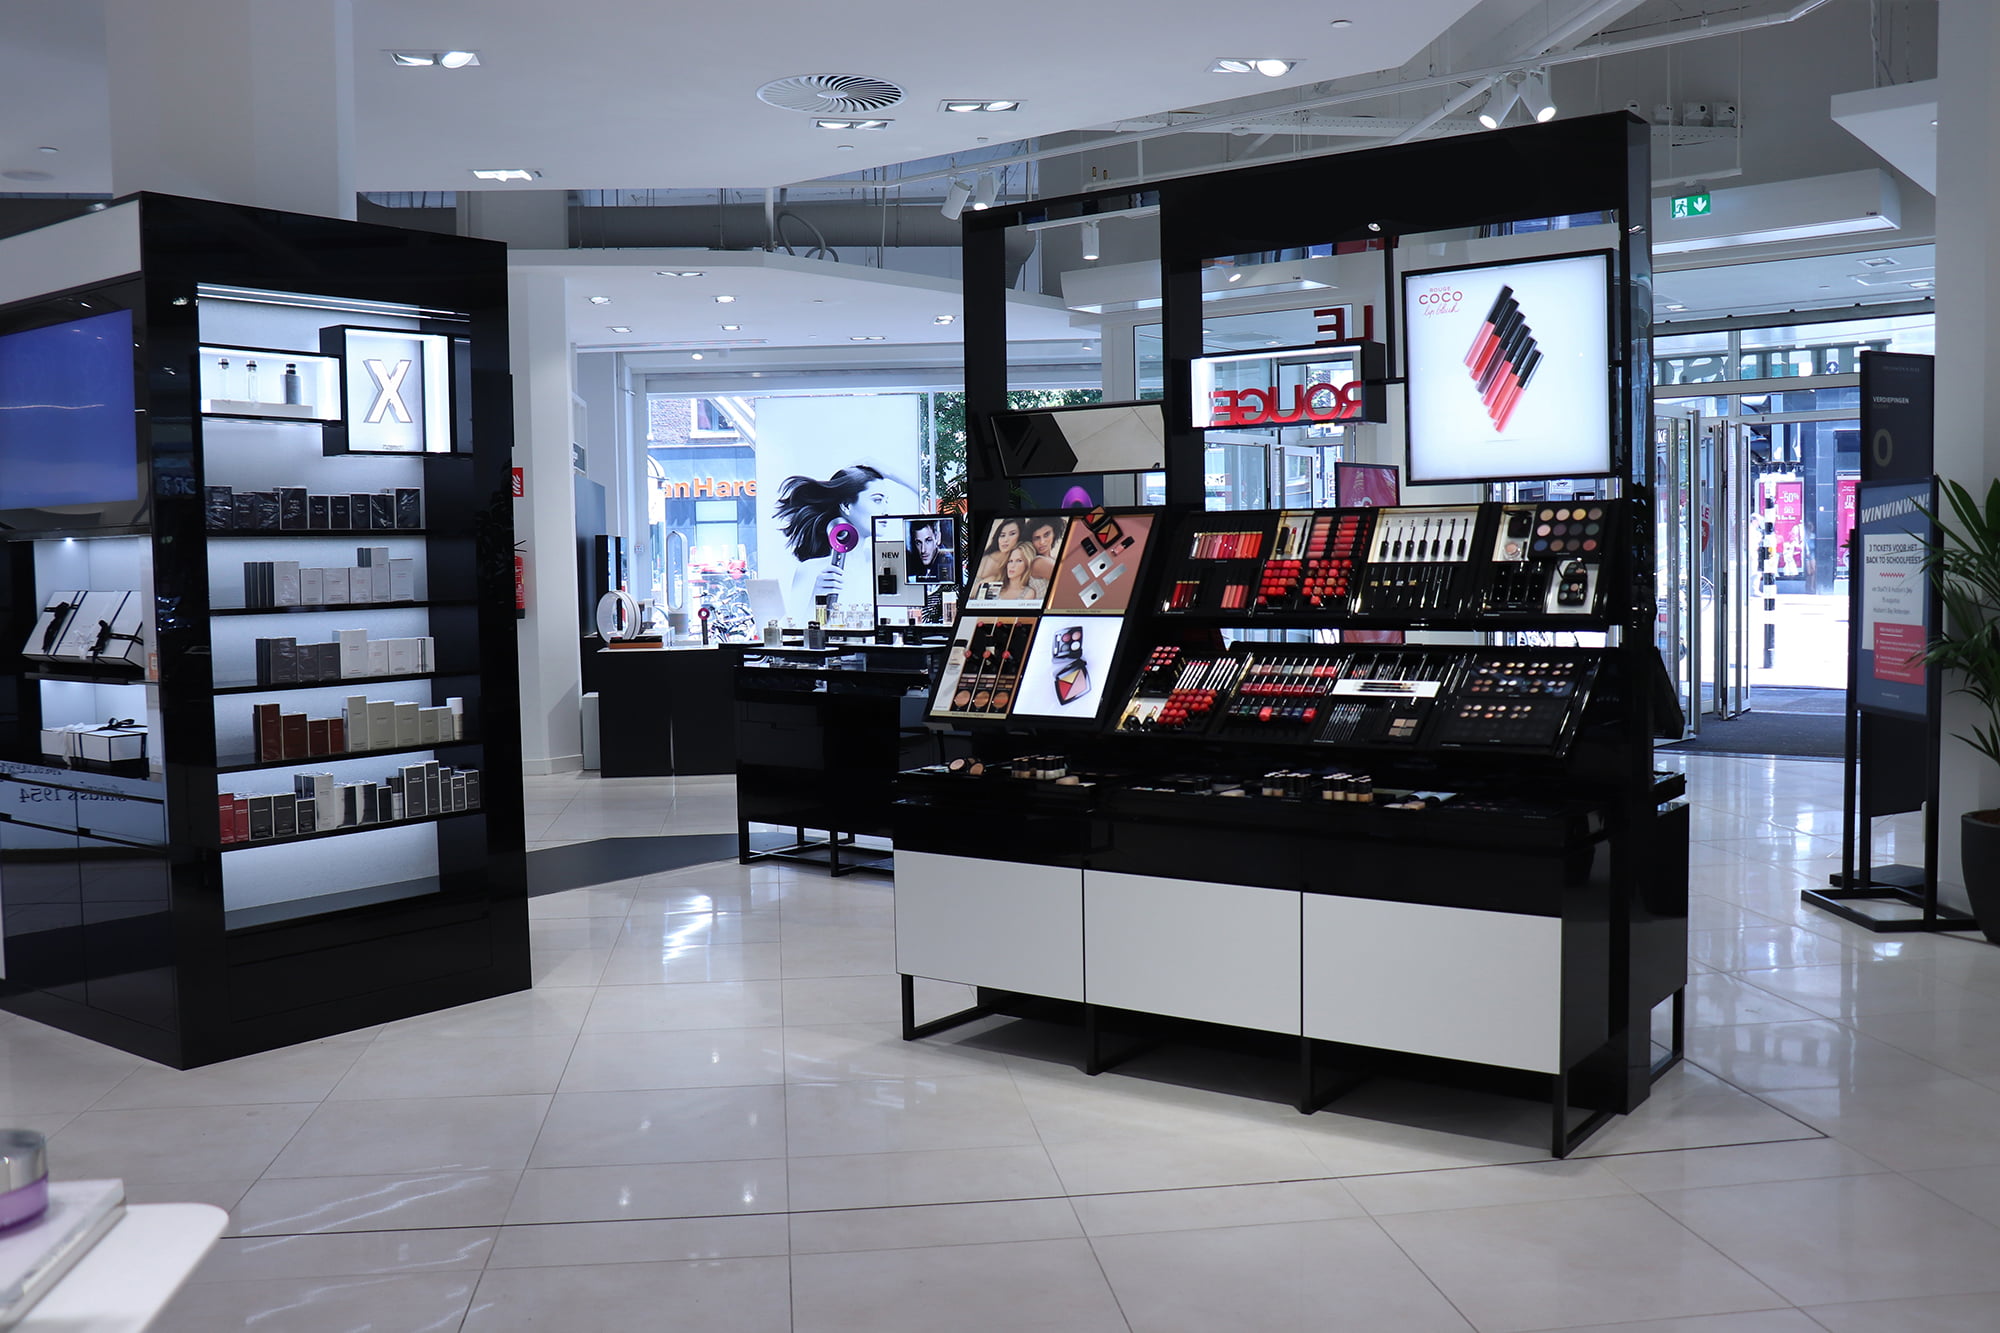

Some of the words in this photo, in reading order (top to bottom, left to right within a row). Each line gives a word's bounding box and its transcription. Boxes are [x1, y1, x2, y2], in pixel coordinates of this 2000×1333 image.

[1418, 290, 1463, 305] COCO
[364, 360, 412, 424] X
[1873, 396, 1910, 404] VERDIEPINGEN
[1861, 492, 1930, 524] WINWINWIN!
[1873, 544, 1892, 552] TICKETS
[1893, 544, 1906, 552] VOOR
[1907, 543, 1918, 552] HET
[882, 551, 900, 559] NEW
[1866, 556, 1878, 564] BACK
[1879, 556, 1886, 564] TO
[1886, 556, 1921, 565] SCHOOLFEEST
